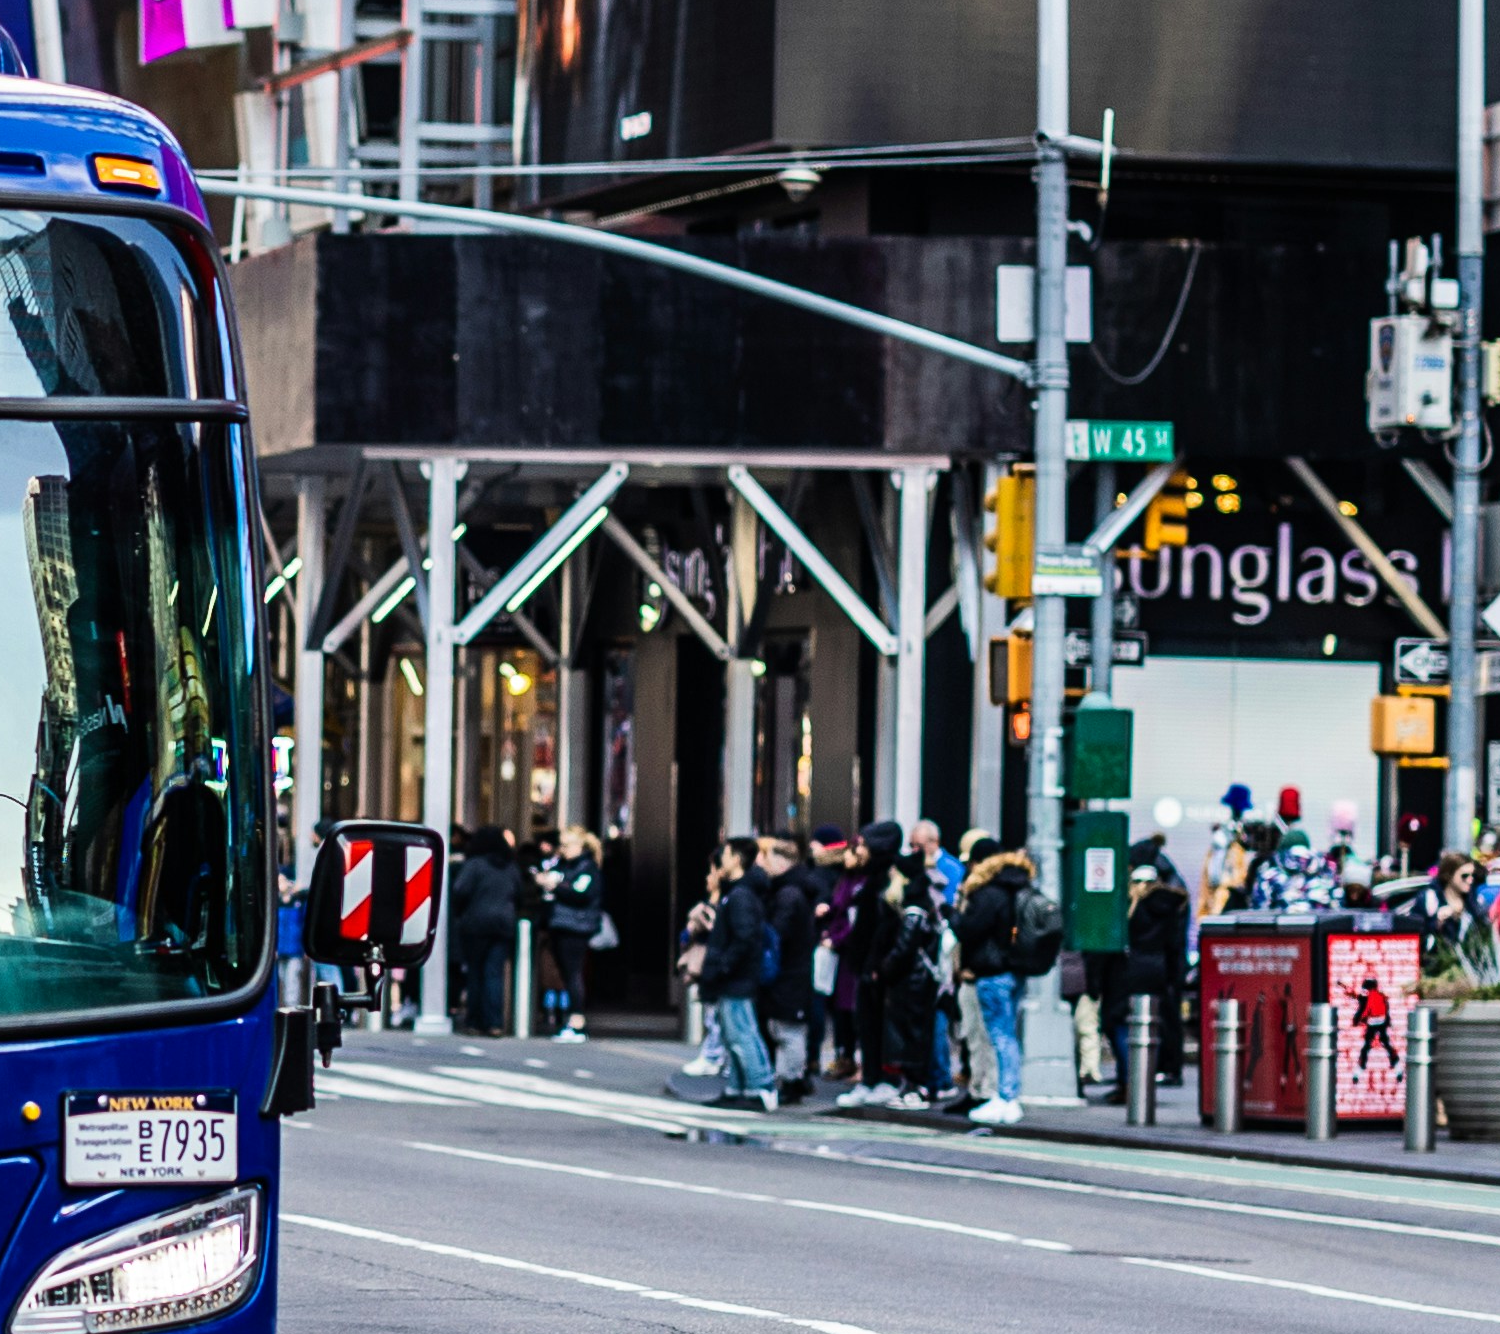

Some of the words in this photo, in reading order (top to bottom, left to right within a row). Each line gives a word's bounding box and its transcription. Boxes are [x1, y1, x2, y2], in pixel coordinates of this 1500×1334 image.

[1093, 428, 1112, 455] W
[1122, 426, 1147, 457] 45
[1112, 521, 1419, 626] unglass
[109, 1096, 150, 1112] NEW
[153, 1095, 196, 1111] YORK
[78, 1122, 129, 1133] Metropolitan
[74, 1137, 133, 1148] Transportation
[158, 1118, 226, 1162] 7935
[85, 1152, 123, 1163] Authority
[119, 1167, 147, 1178] NEW
[151, 1166, 184, 1177] YORK
